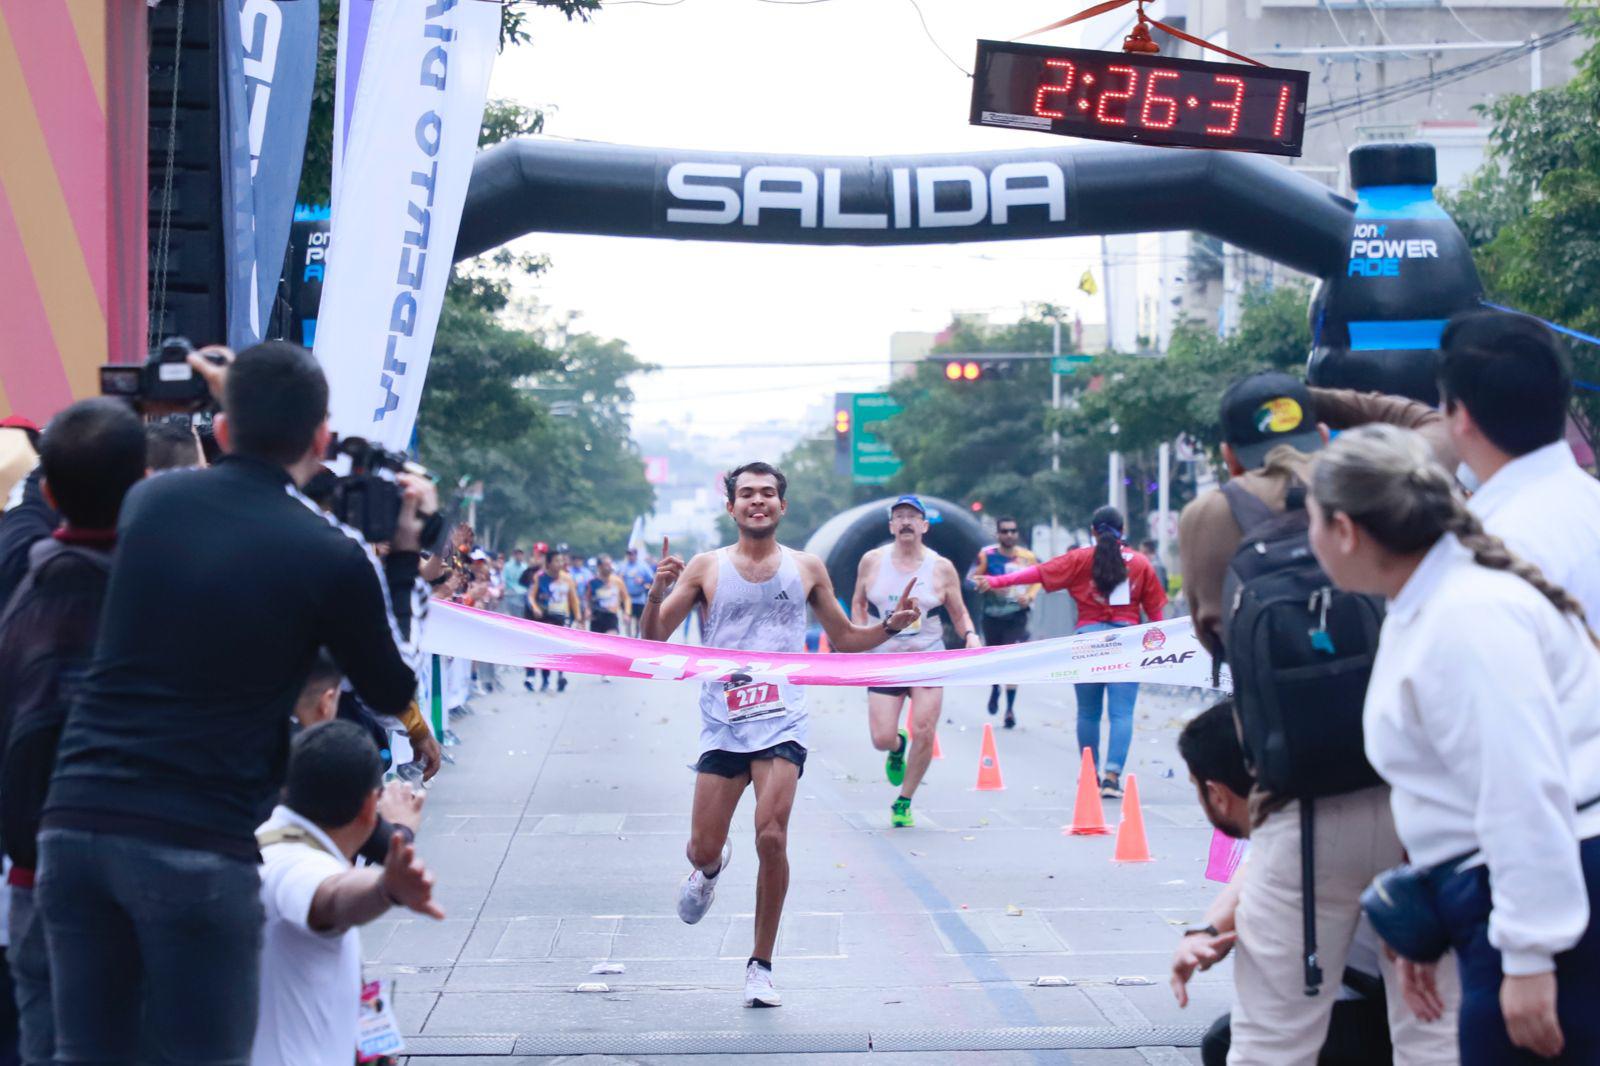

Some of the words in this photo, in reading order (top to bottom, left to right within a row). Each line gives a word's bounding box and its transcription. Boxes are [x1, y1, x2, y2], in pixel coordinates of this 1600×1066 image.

[666, 161, 1067, 229] SALIDA
[1350, 239, 1439, 258] POWER
[1347, 258, 1400, 277] ADE
[1090, 662, 1132, 673] IMDEC
[1139, 651, 1197, 667] IAAF
[736, 686, 769, 707] 277
